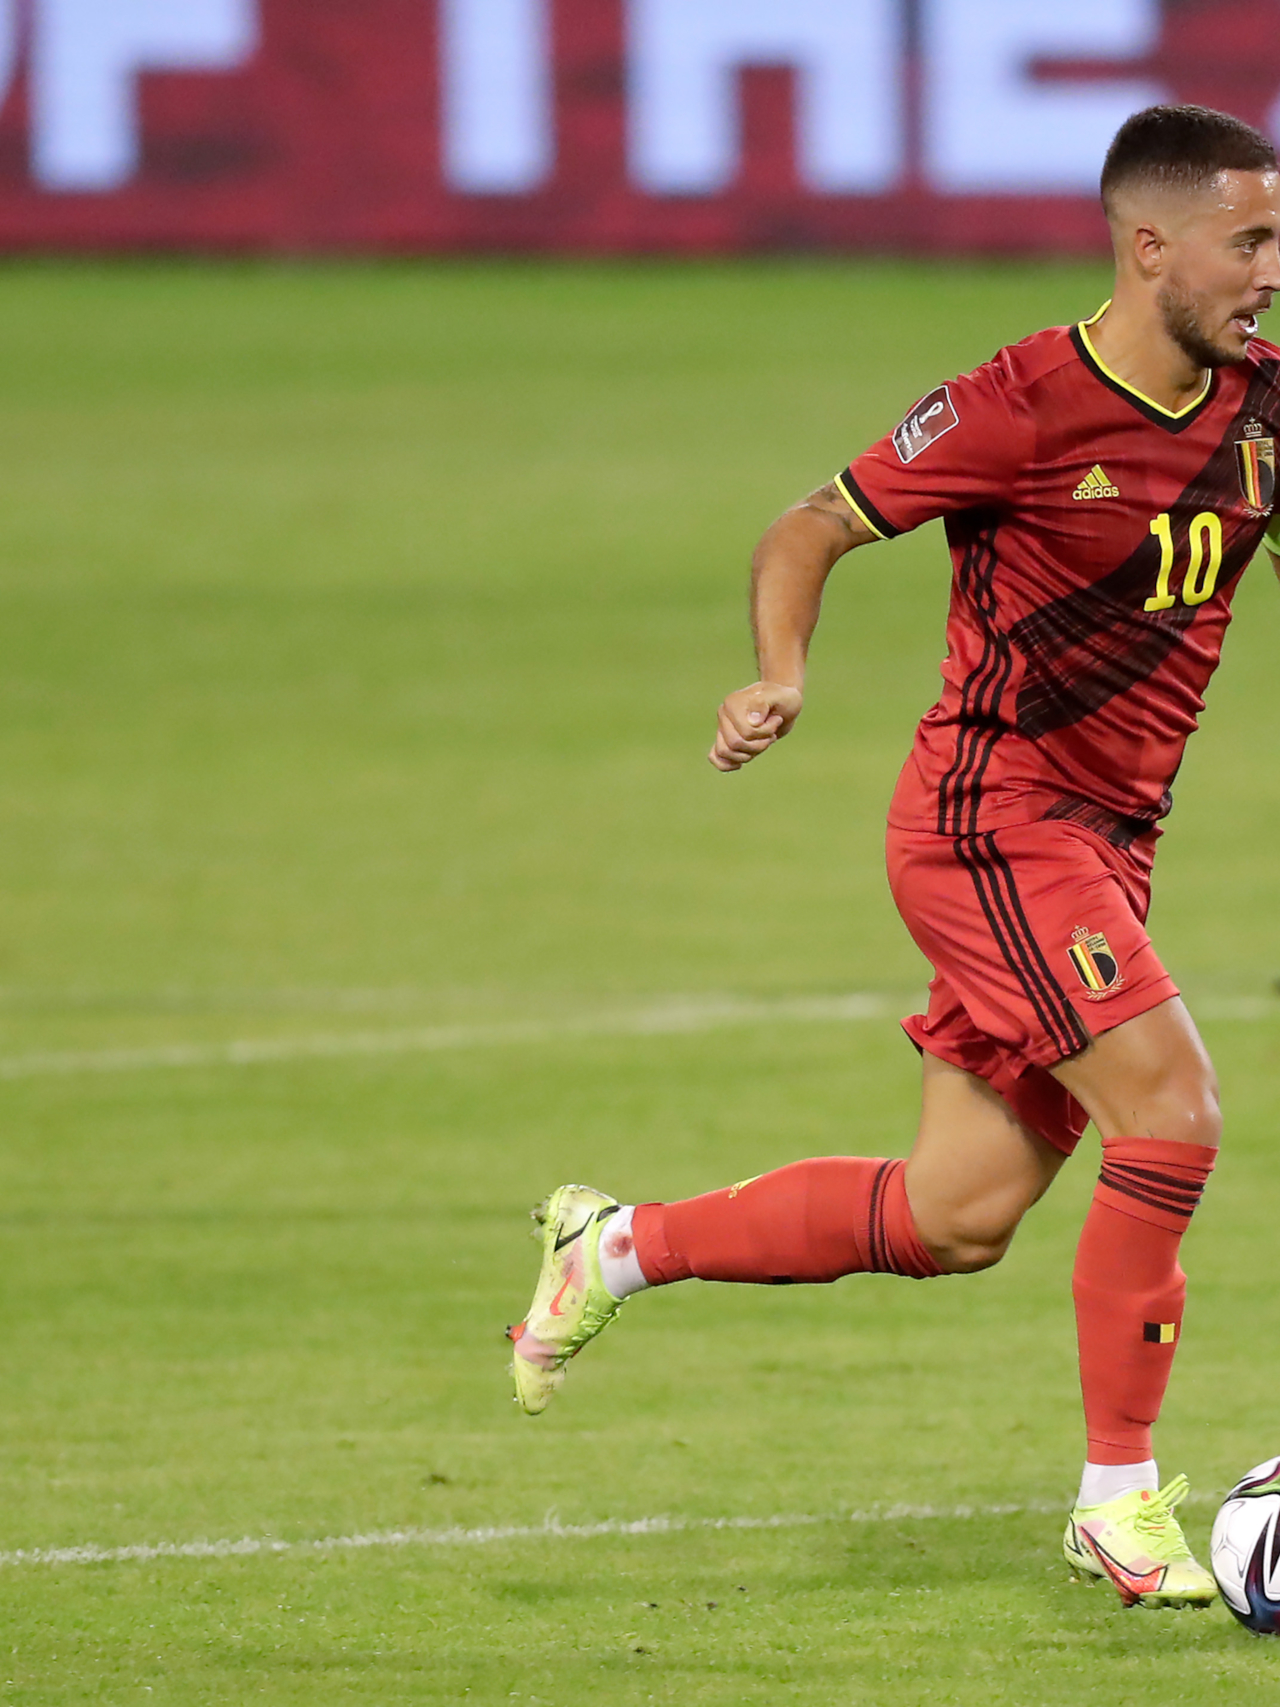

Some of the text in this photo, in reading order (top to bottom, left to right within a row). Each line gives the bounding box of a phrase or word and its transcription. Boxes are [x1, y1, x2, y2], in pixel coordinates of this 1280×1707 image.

[0, 0, 260, 192] F
[1072, 485, 1120, 501] adidas
[1143, 511, 1223, 612] 10
